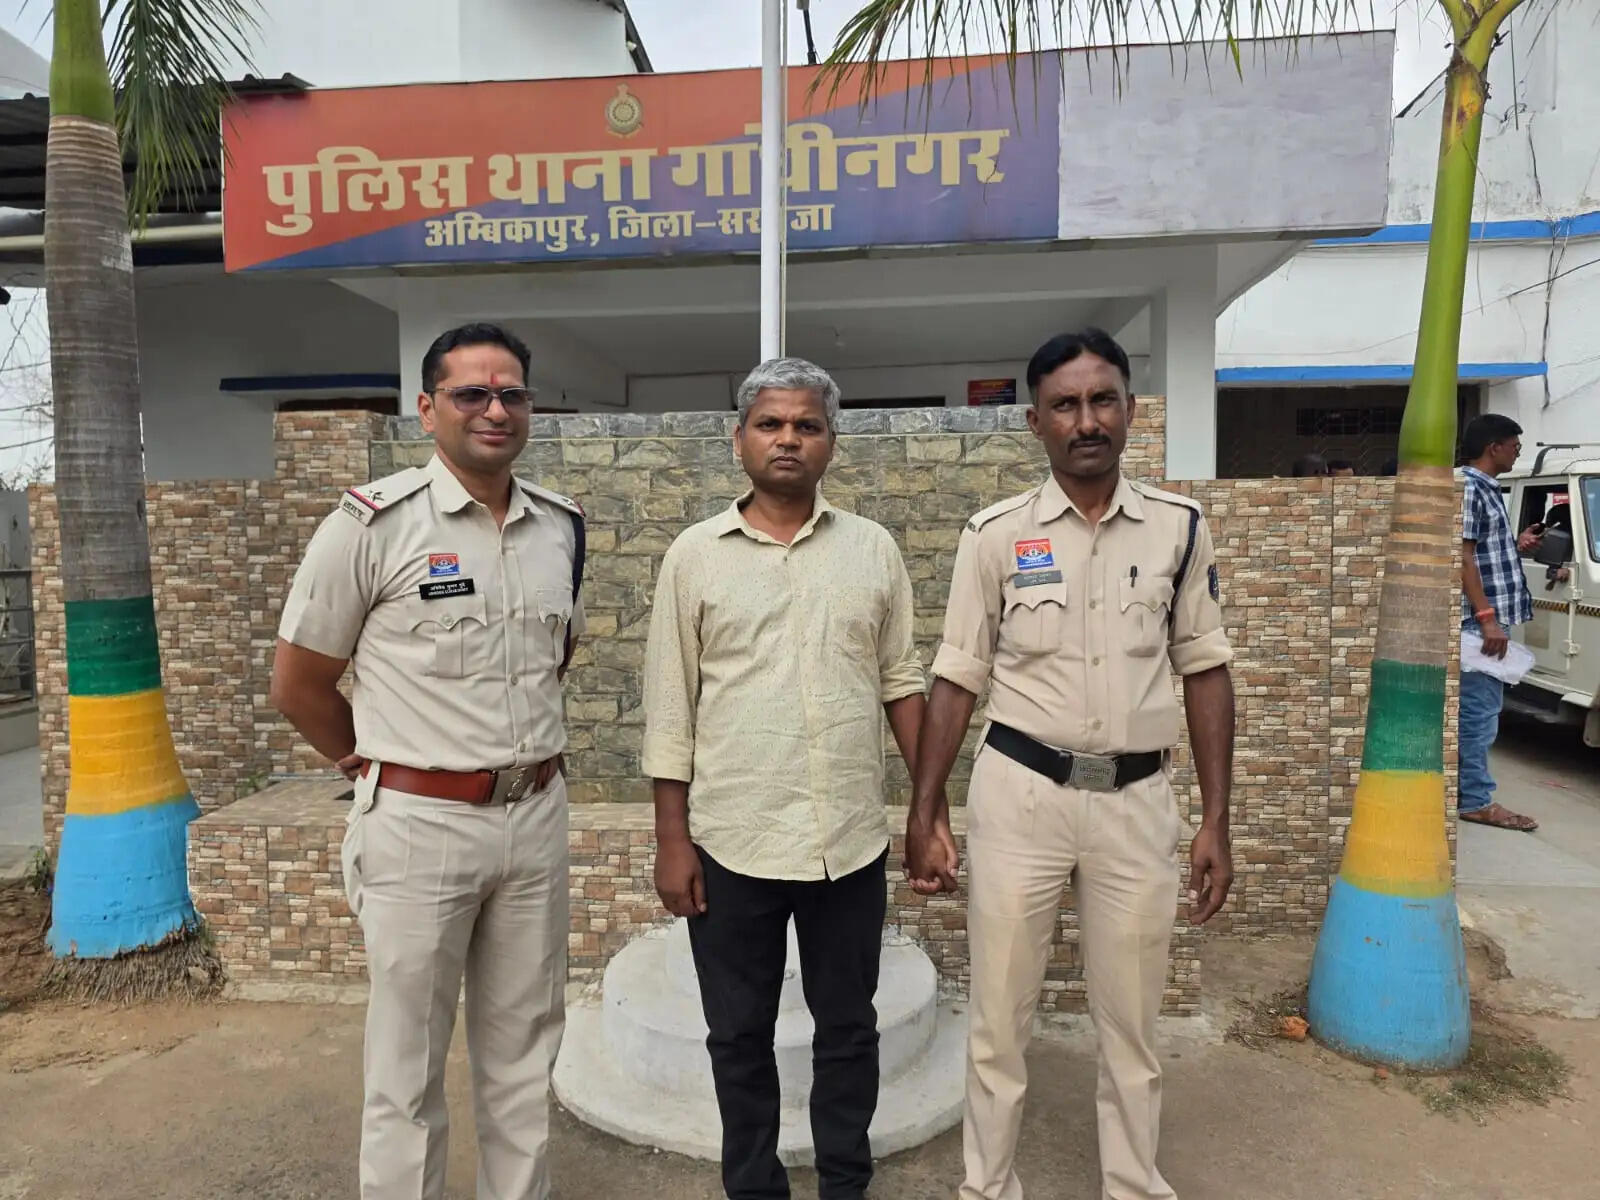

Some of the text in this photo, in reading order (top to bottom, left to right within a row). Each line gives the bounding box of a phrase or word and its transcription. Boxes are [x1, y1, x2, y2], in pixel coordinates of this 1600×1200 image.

[262, 145, 474, 237] पुलिस
[487, 147, 658, 205] थाना
[424, 211, 600, 252] अम्बिकापुर,
